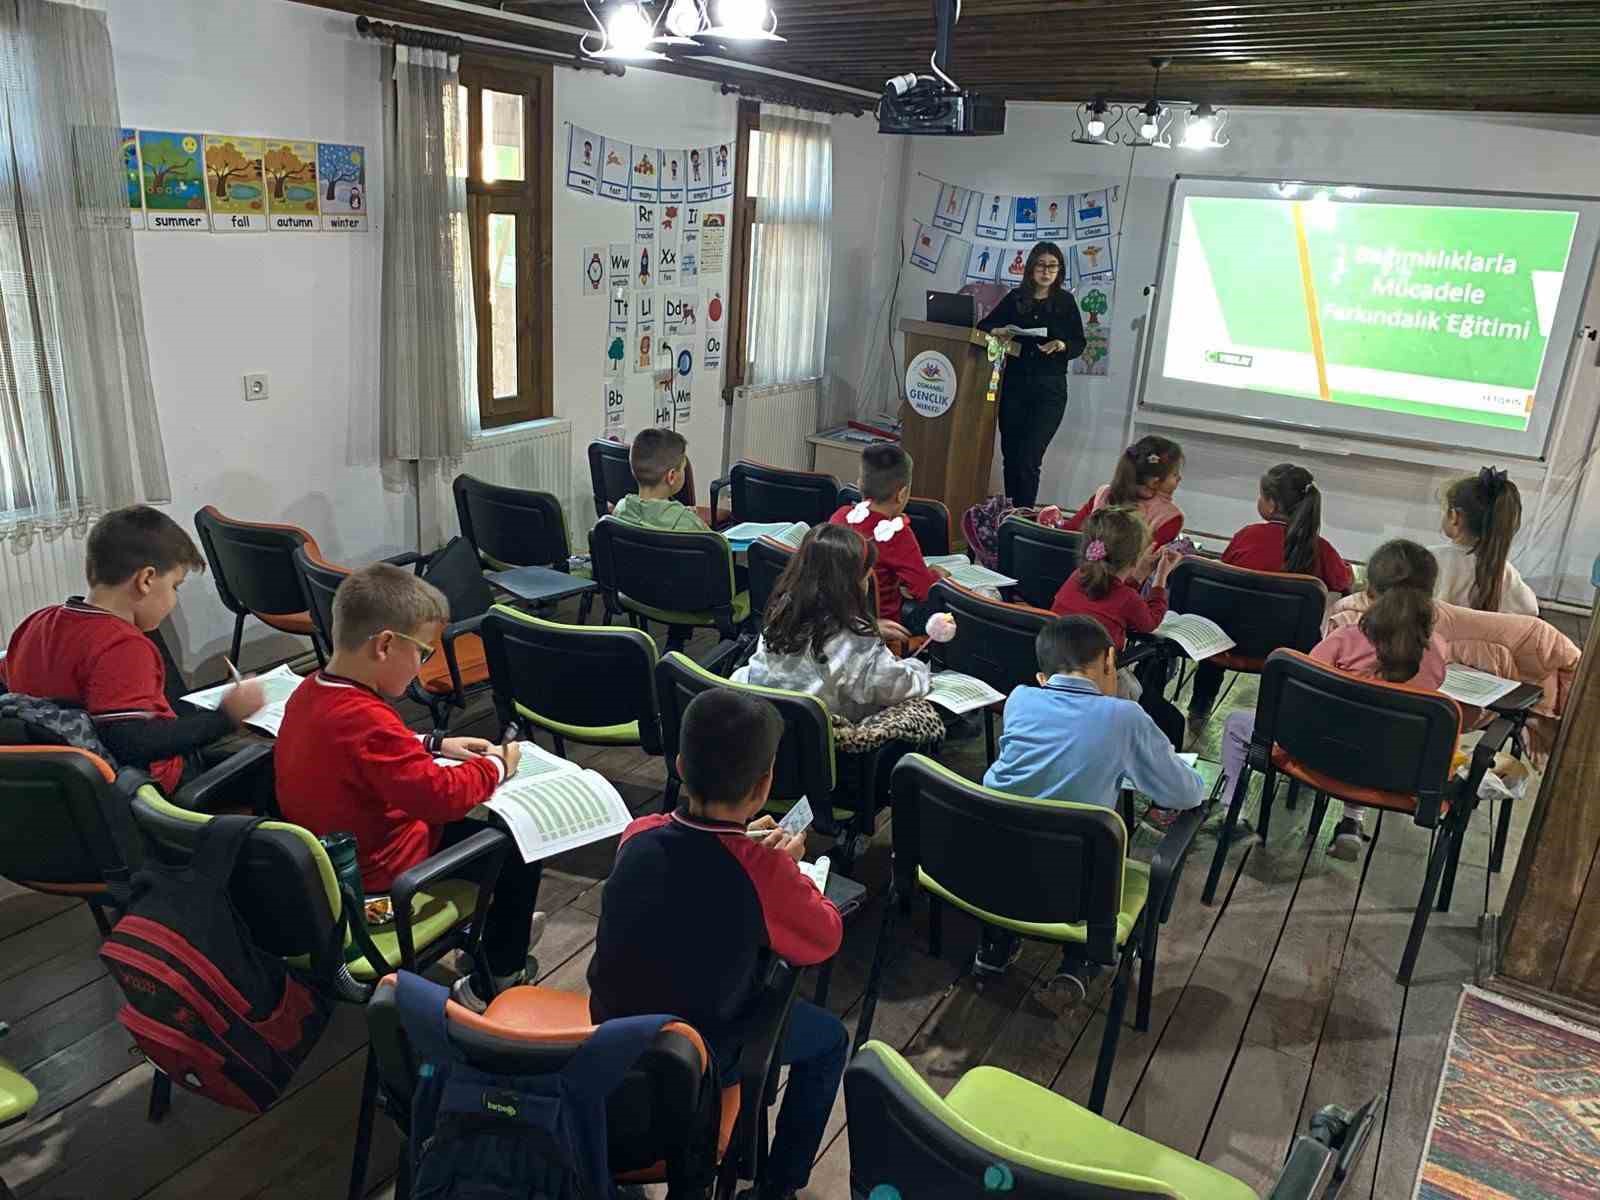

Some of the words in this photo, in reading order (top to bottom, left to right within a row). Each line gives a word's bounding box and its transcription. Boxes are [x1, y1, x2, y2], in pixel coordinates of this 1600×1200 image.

[639, 205, 653, 222] Rr
[688, 209, 698, 224] Ii
[155, 215, 203, 228] summer
[231, 215, 250, 228] fall
[277, 215, 313, 228] autumn
[330, 217, 360, 229] winter
[611, 255, 630, 270] Ww
[660, 249, 676, 265] Xx
[667, 298, 682, 316] Dd
[1448, 312, 1531, 340] Eğitimi
[707, 337, 720, 352] Oo
[608, 390, 623, 407] Bb
[656, 408, 671, 424] Hh
